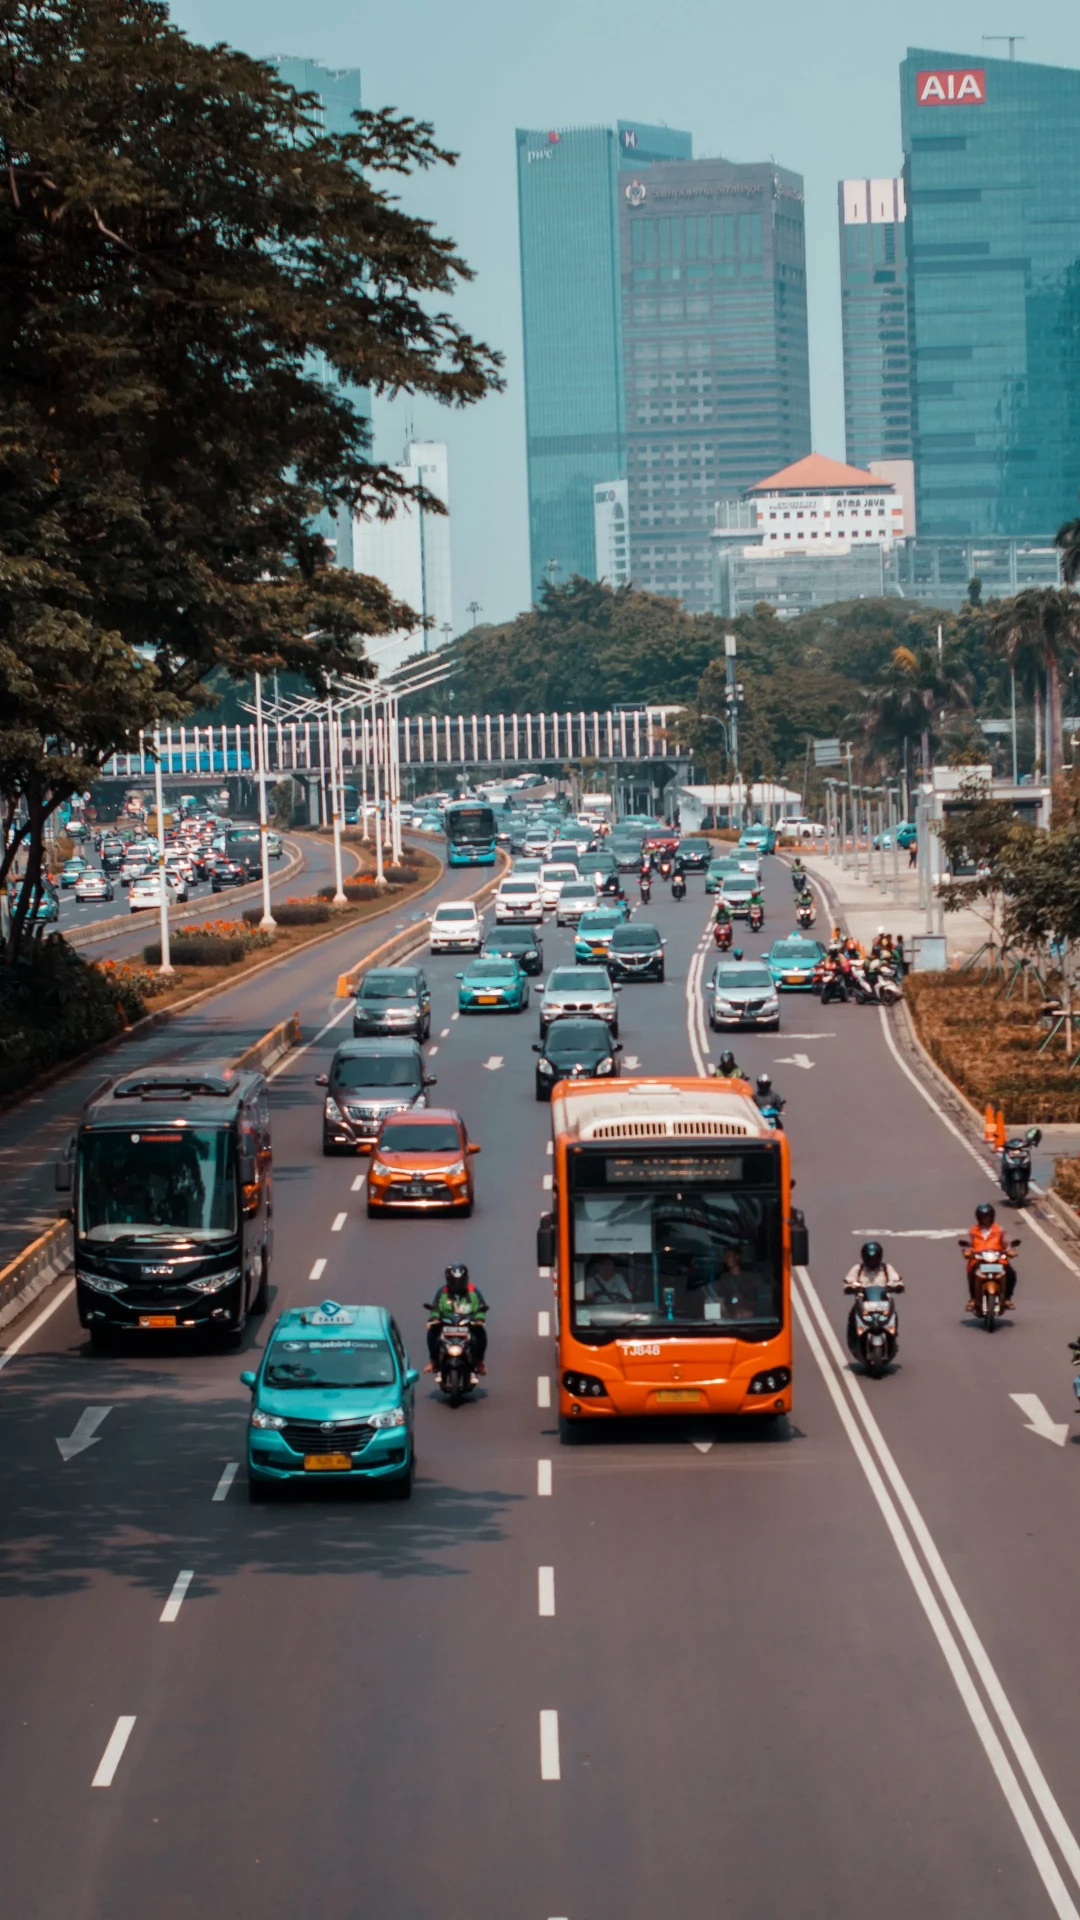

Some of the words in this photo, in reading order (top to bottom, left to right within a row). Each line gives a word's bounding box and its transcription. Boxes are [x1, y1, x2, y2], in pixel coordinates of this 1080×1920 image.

[921, 74, 982, 101] AIA
[528, 148, 553, 163] pwc
[836, 499, 861, 508] ATMA
[864, 498, 885, 507] JAVA
[308, 1341, 351, 1349] Bluebird
[621, 1345, 661, 1356] TJ848
